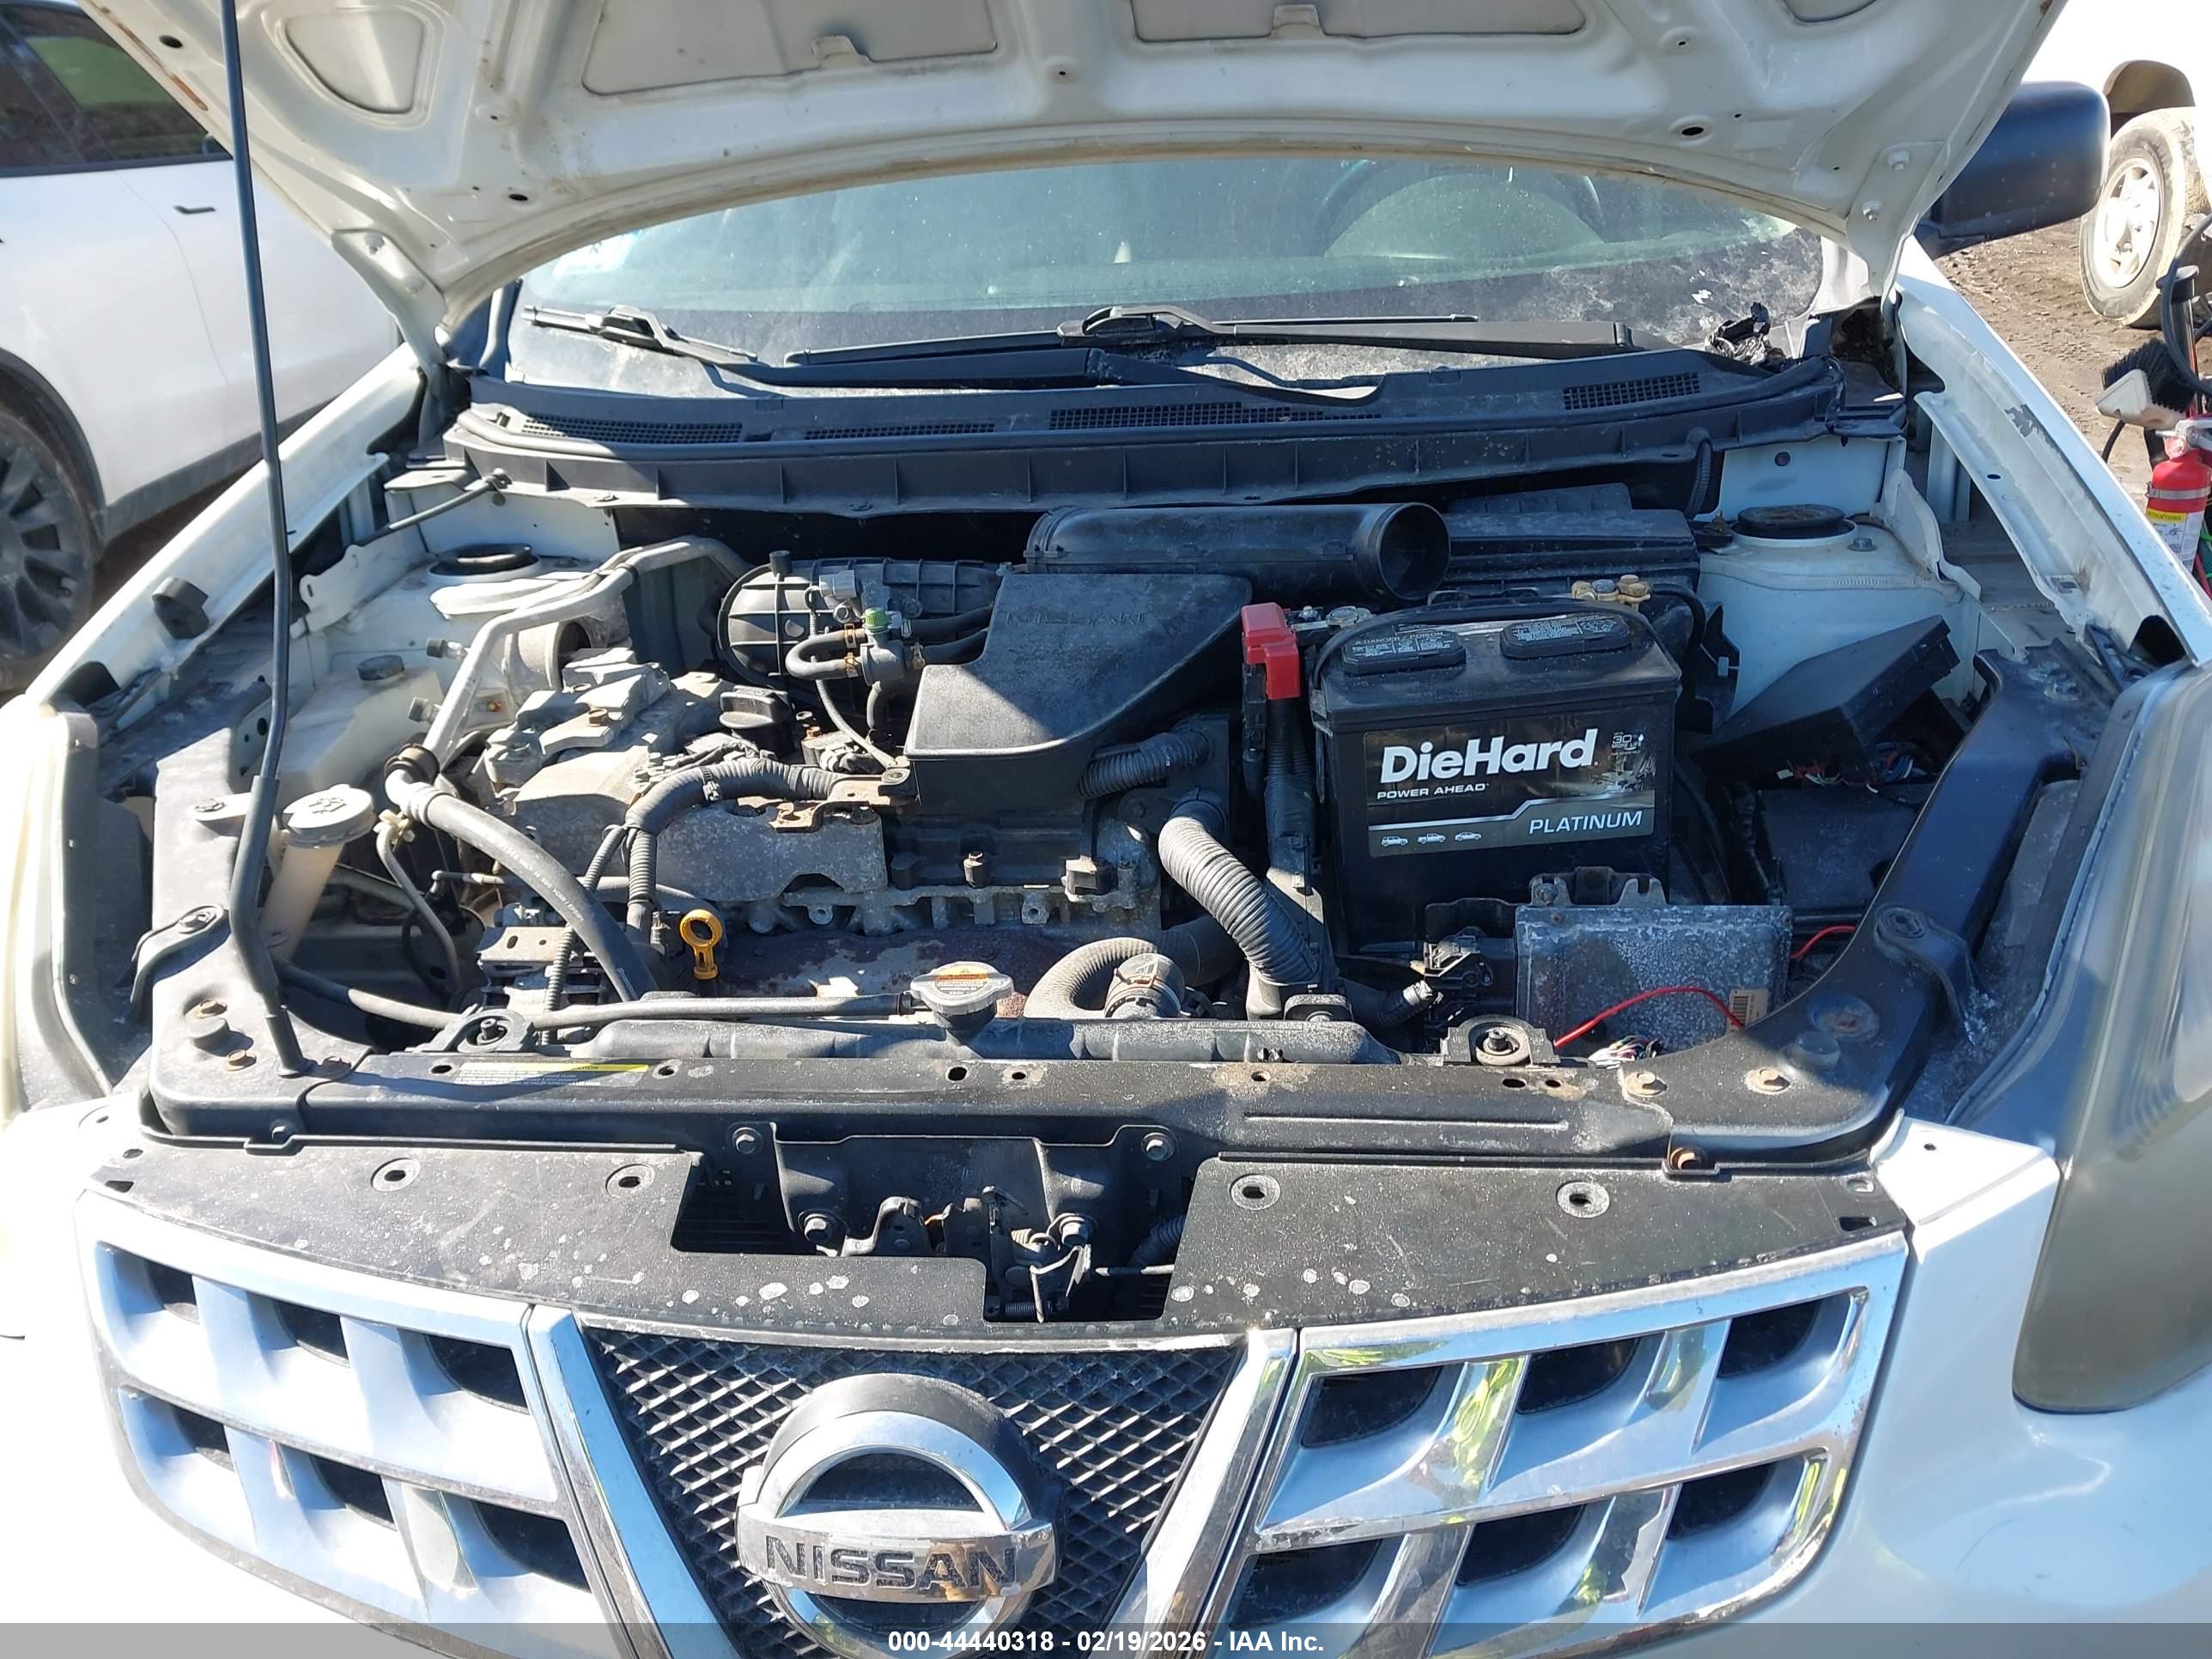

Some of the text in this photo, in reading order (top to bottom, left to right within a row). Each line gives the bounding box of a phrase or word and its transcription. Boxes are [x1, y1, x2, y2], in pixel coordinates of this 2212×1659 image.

[1002, 611, 1148, 626] NISSAN
[1380, 728, 1599, 784] DieHard
[1376, 782, 1487, 800] POWER AHEAD
[1528, 810, 1644, 836] PLATINUM
[765, 1534, 1017, 1592] NISSAN
